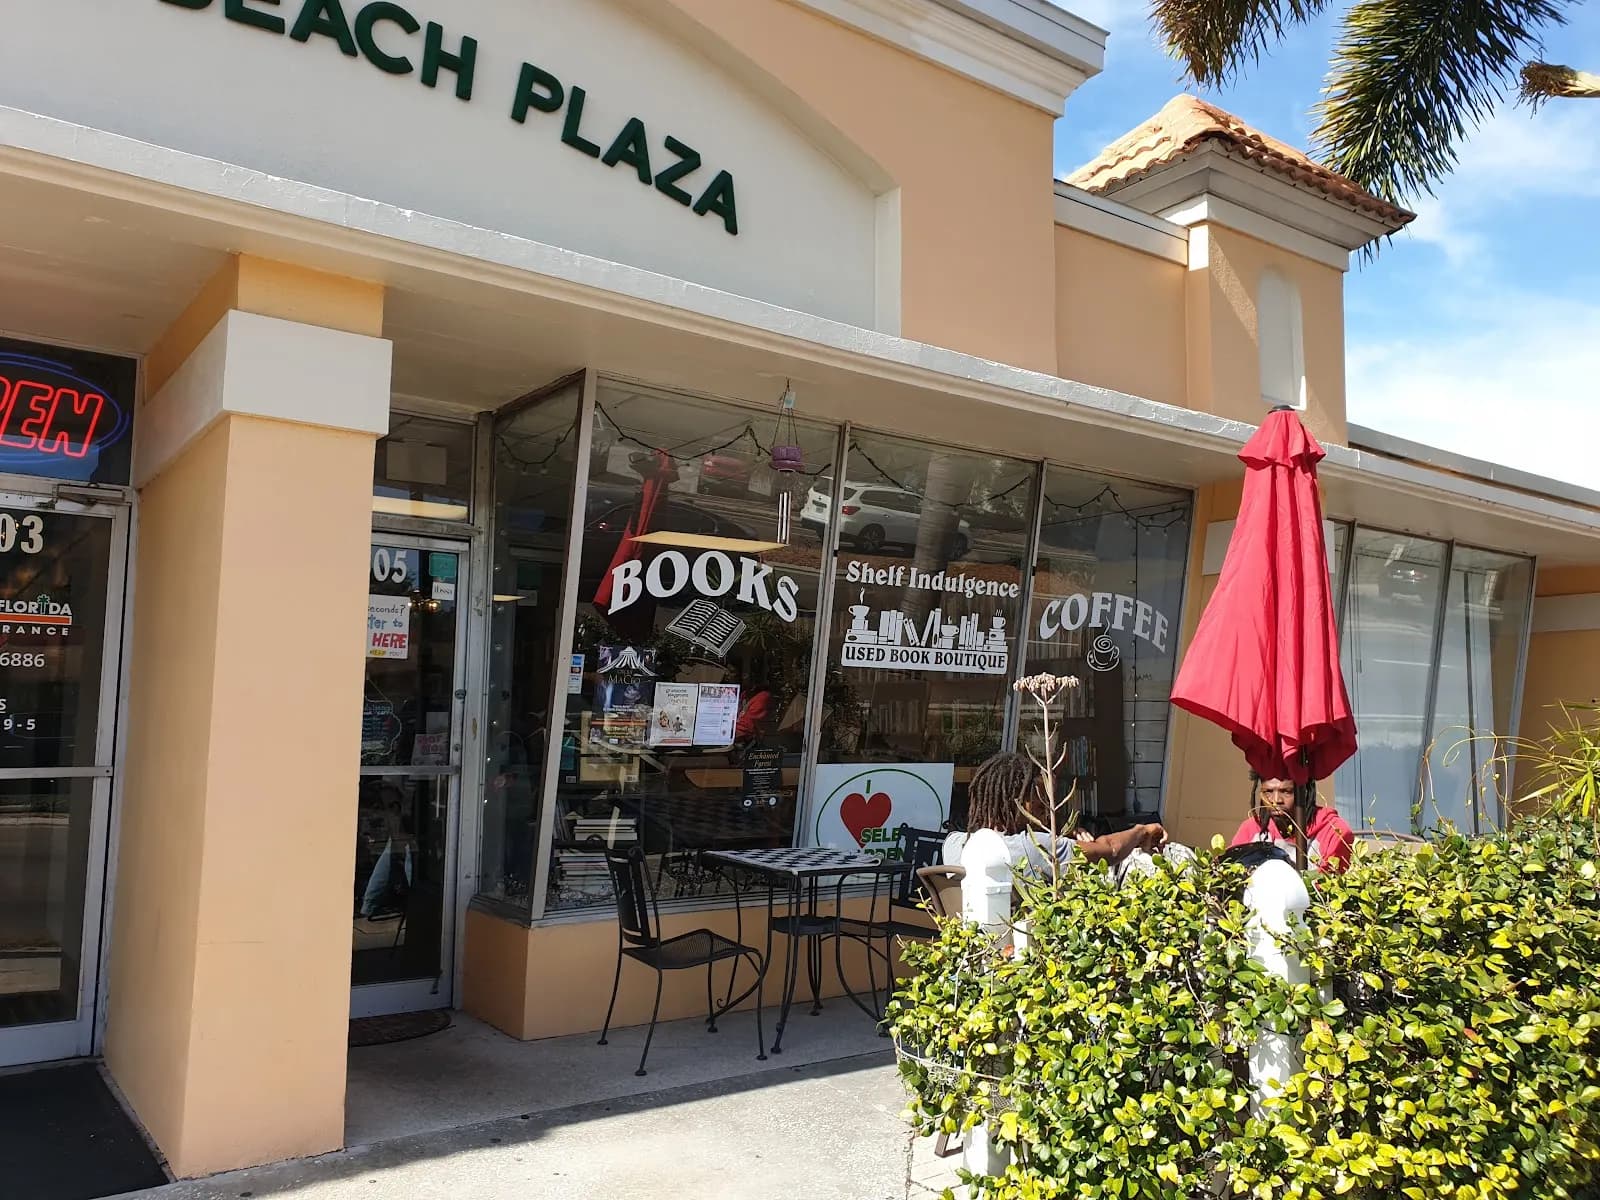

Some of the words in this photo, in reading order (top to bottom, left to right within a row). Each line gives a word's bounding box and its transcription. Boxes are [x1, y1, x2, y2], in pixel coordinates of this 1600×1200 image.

[157, 0, 477, 101] ACH
[511, 62, 738, 236] PLAZA
[0, 376, 104, 458] EN
[373, 548, 407, 583] 05
[845, 560, 906, 587] Shelf
[908, 567, 1020, 599] Indulgence
[608, 550, 799, 623] BOOKS
[368, 604, 406, 616] econds?
[1039, 592, 1169, 653] COFFEE
[371, 632, 408, 649] HERE
[845, 646, 886, 662] USED
[889, 649, 930, 665] BOOK
[934, 652, 1006, 671] BOUTIQUE
[865, 779, 872, 794] I
